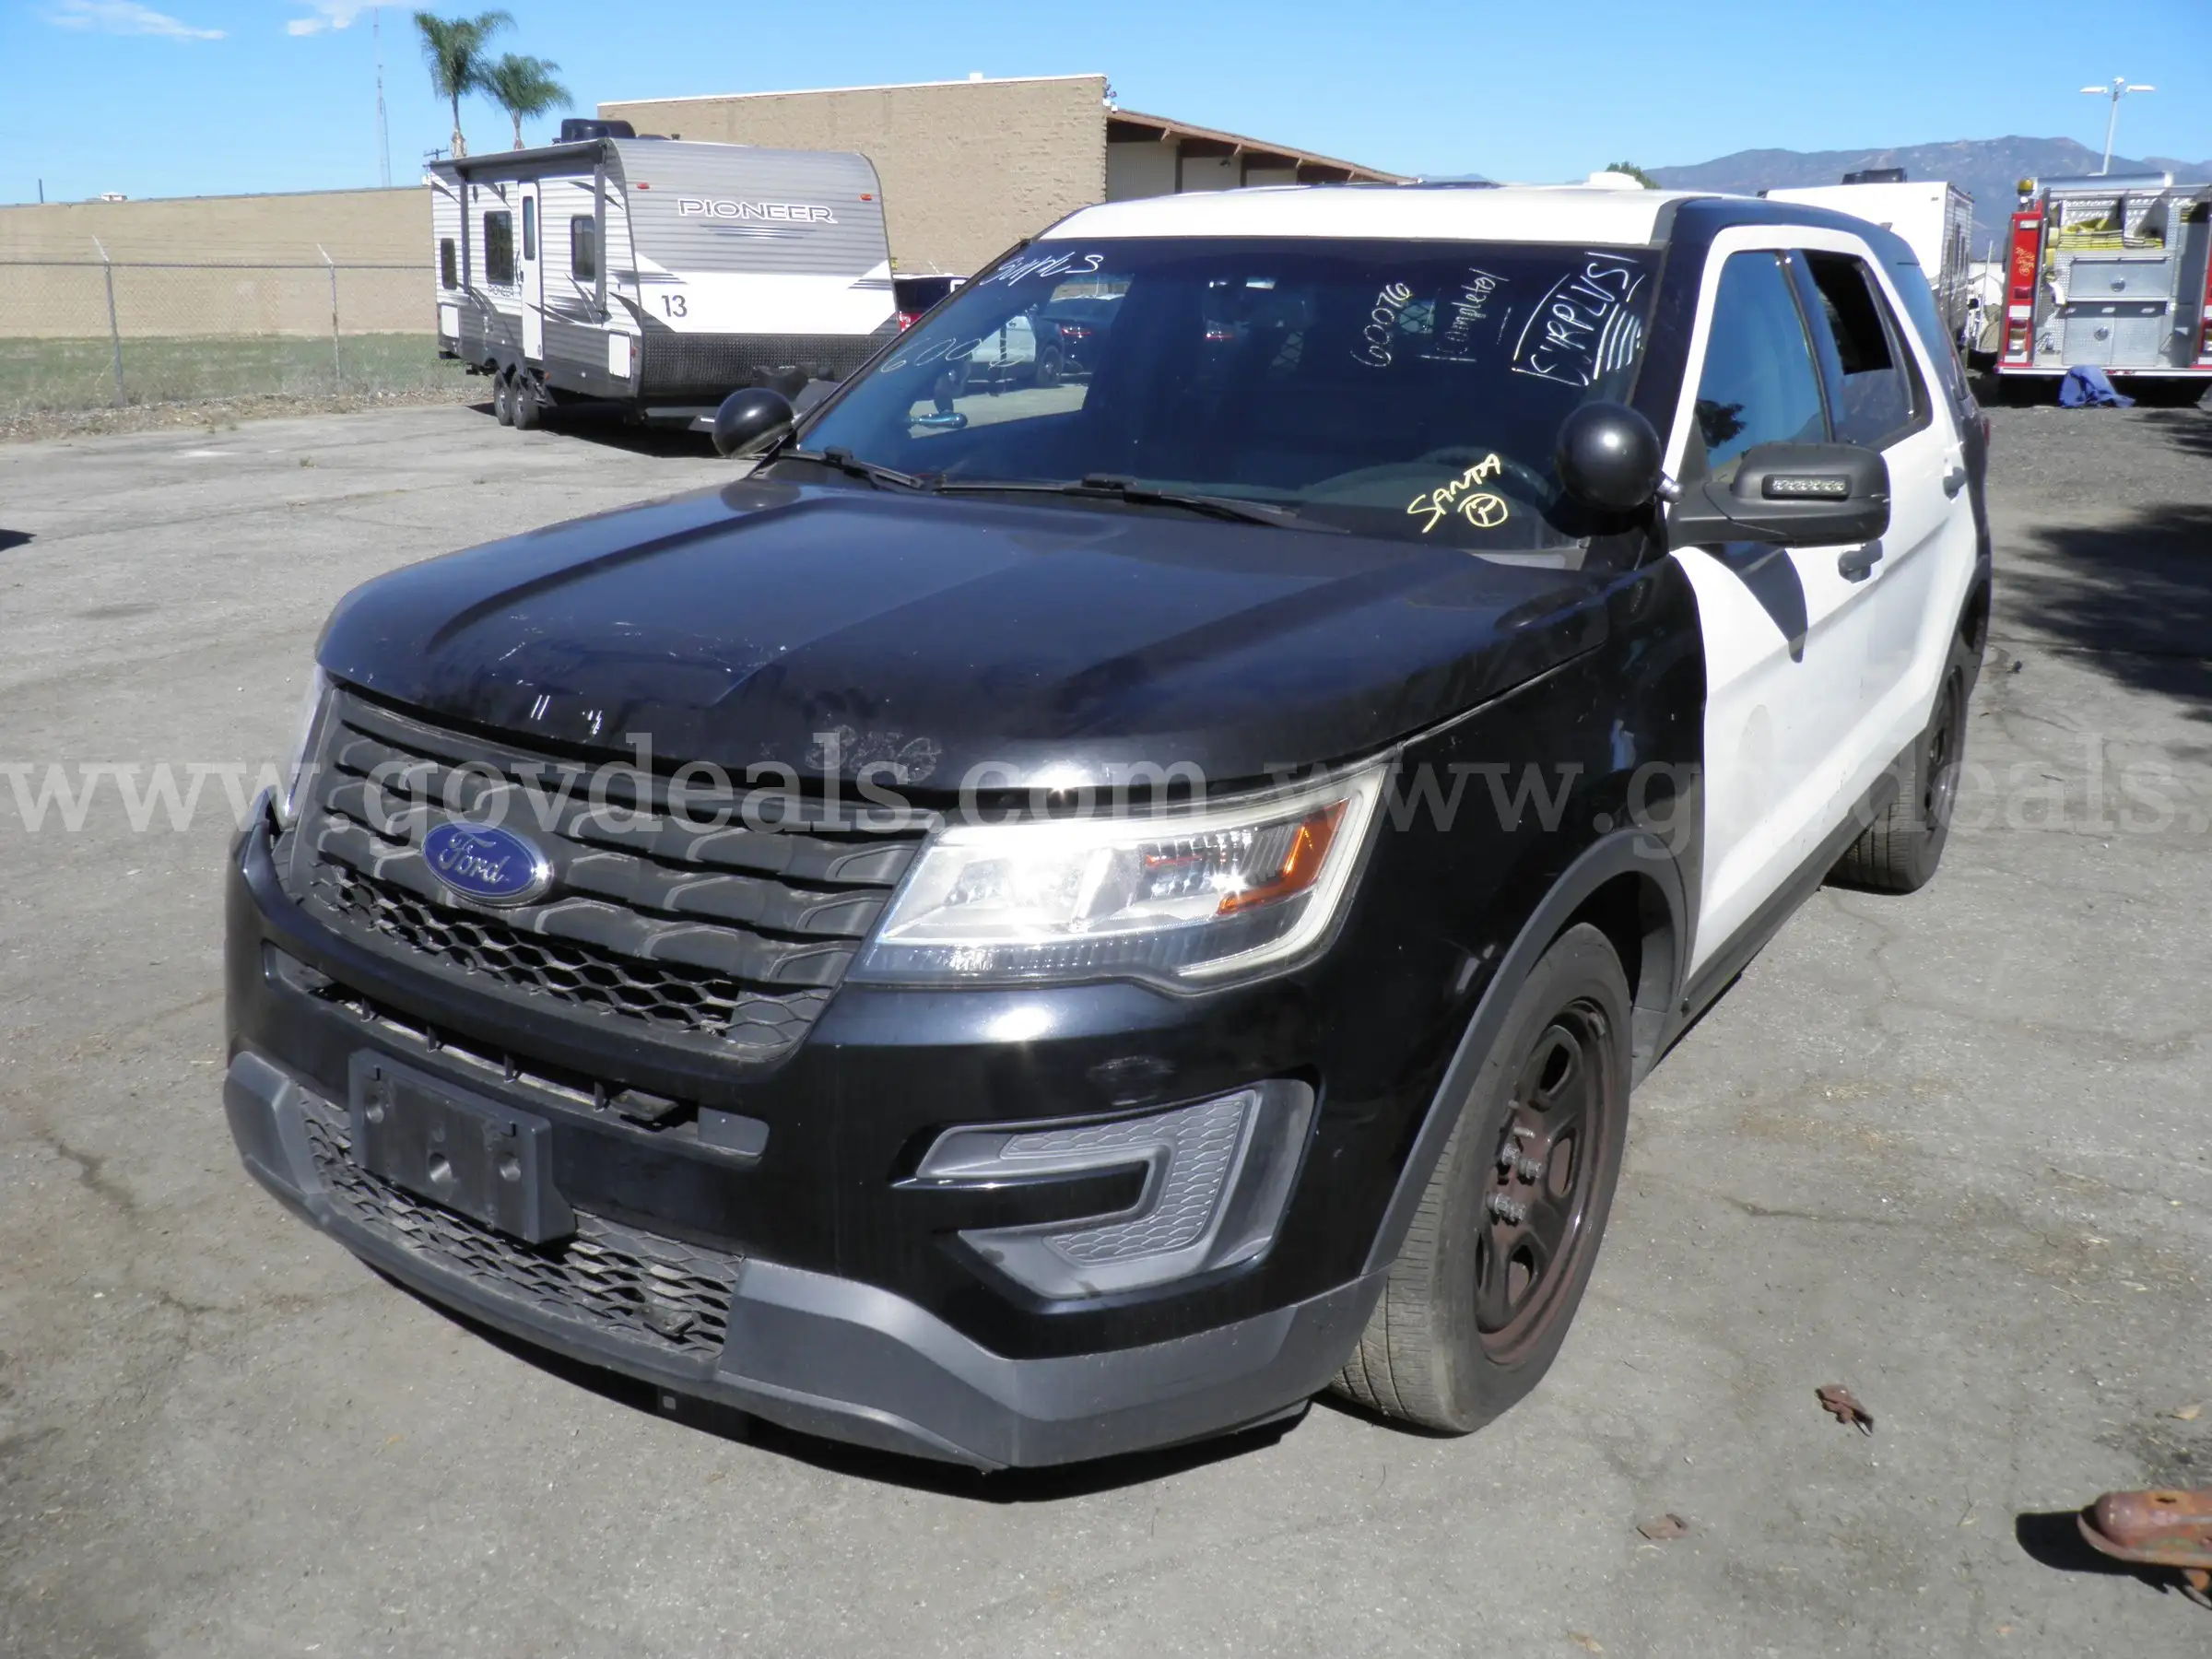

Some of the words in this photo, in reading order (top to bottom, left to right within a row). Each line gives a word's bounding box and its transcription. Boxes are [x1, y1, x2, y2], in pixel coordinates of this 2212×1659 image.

[677, 197, 839, 224] PIONEER
[661, 294, 688, 318] 13
[1349, 282, 1412, 368] 60076
[1406, 453, 1501, 534] SANTA
[438, 831, 512, 885] Ford
